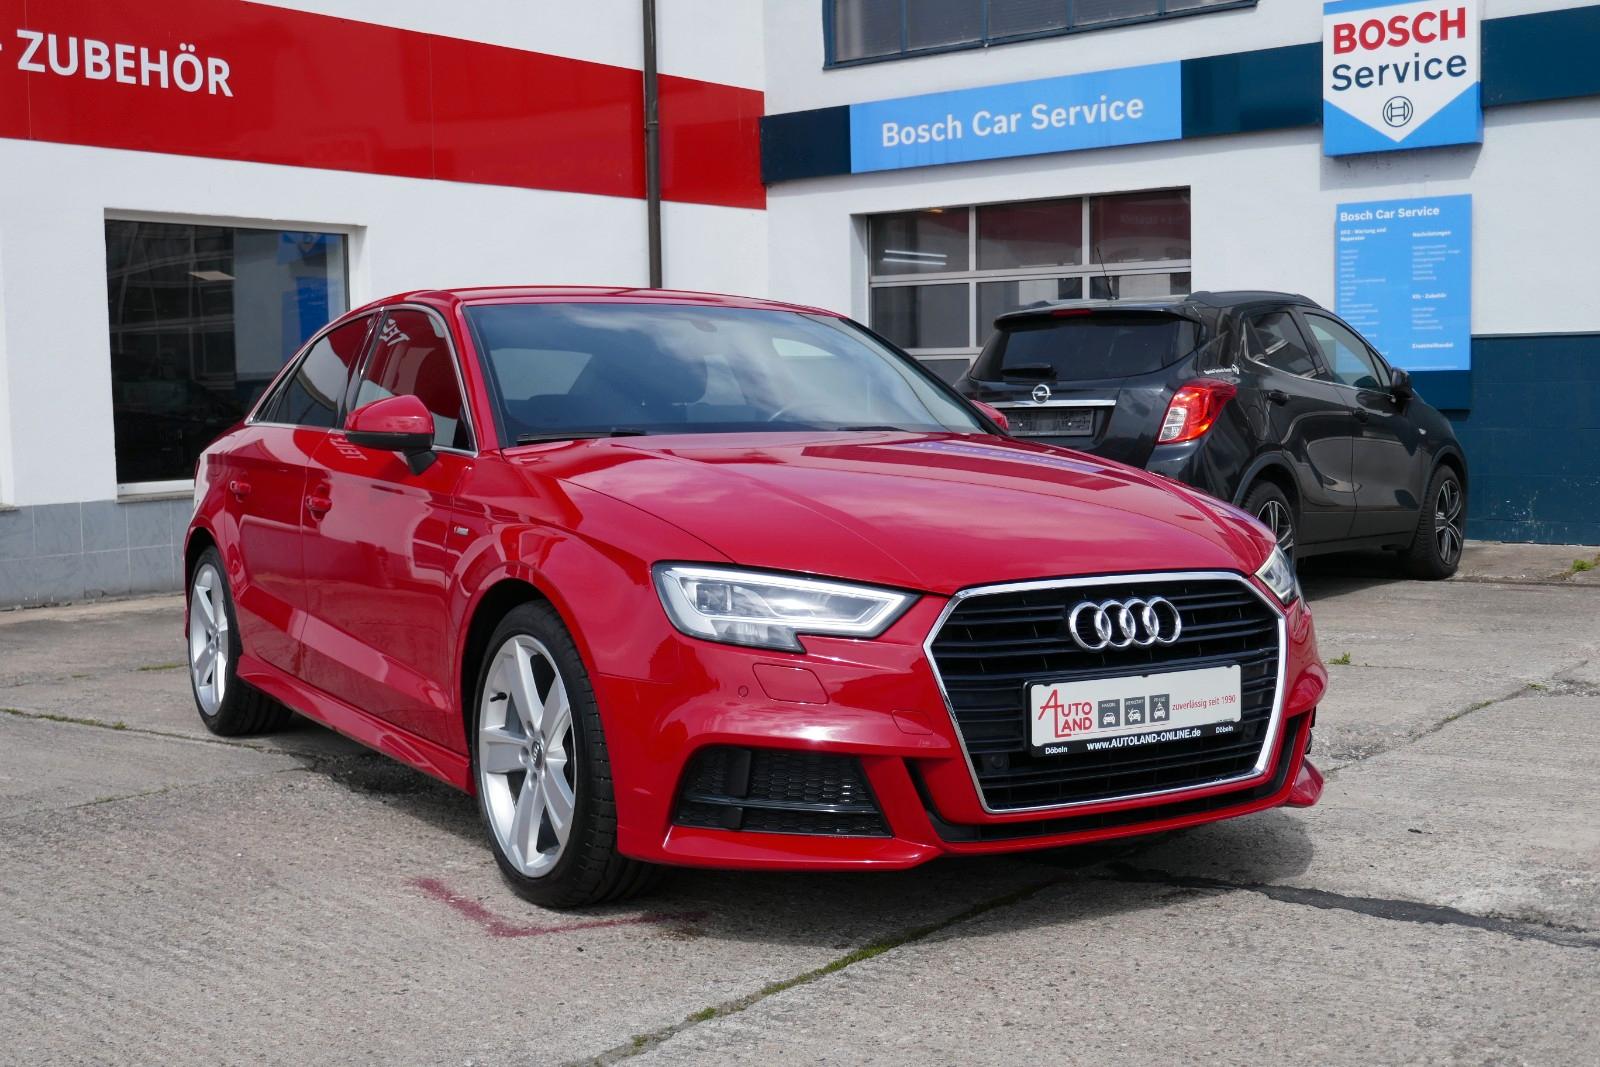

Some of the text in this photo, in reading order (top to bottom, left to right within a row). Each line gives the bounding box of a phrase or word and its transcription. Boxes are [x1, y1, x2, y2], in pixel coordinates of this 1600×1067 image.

[1333, 7, 1466, 55] BOSCH
[16, 29, 234, 97] ZUBEHÖR
[1331, 52, 1467, 92] Service
[881, 95, 1145, 147] Bosch Car Service
[1340, 206, 1441, 222] Bosch Car Service
[1038, 689, 1093, 721] AUTO
[1055, 716, 1093, 738] LAND
[1086, 728, 1202, 750] www.AUTOLAND-ONLINE.de
[1045, 746, 1068, 754] Döbeln
